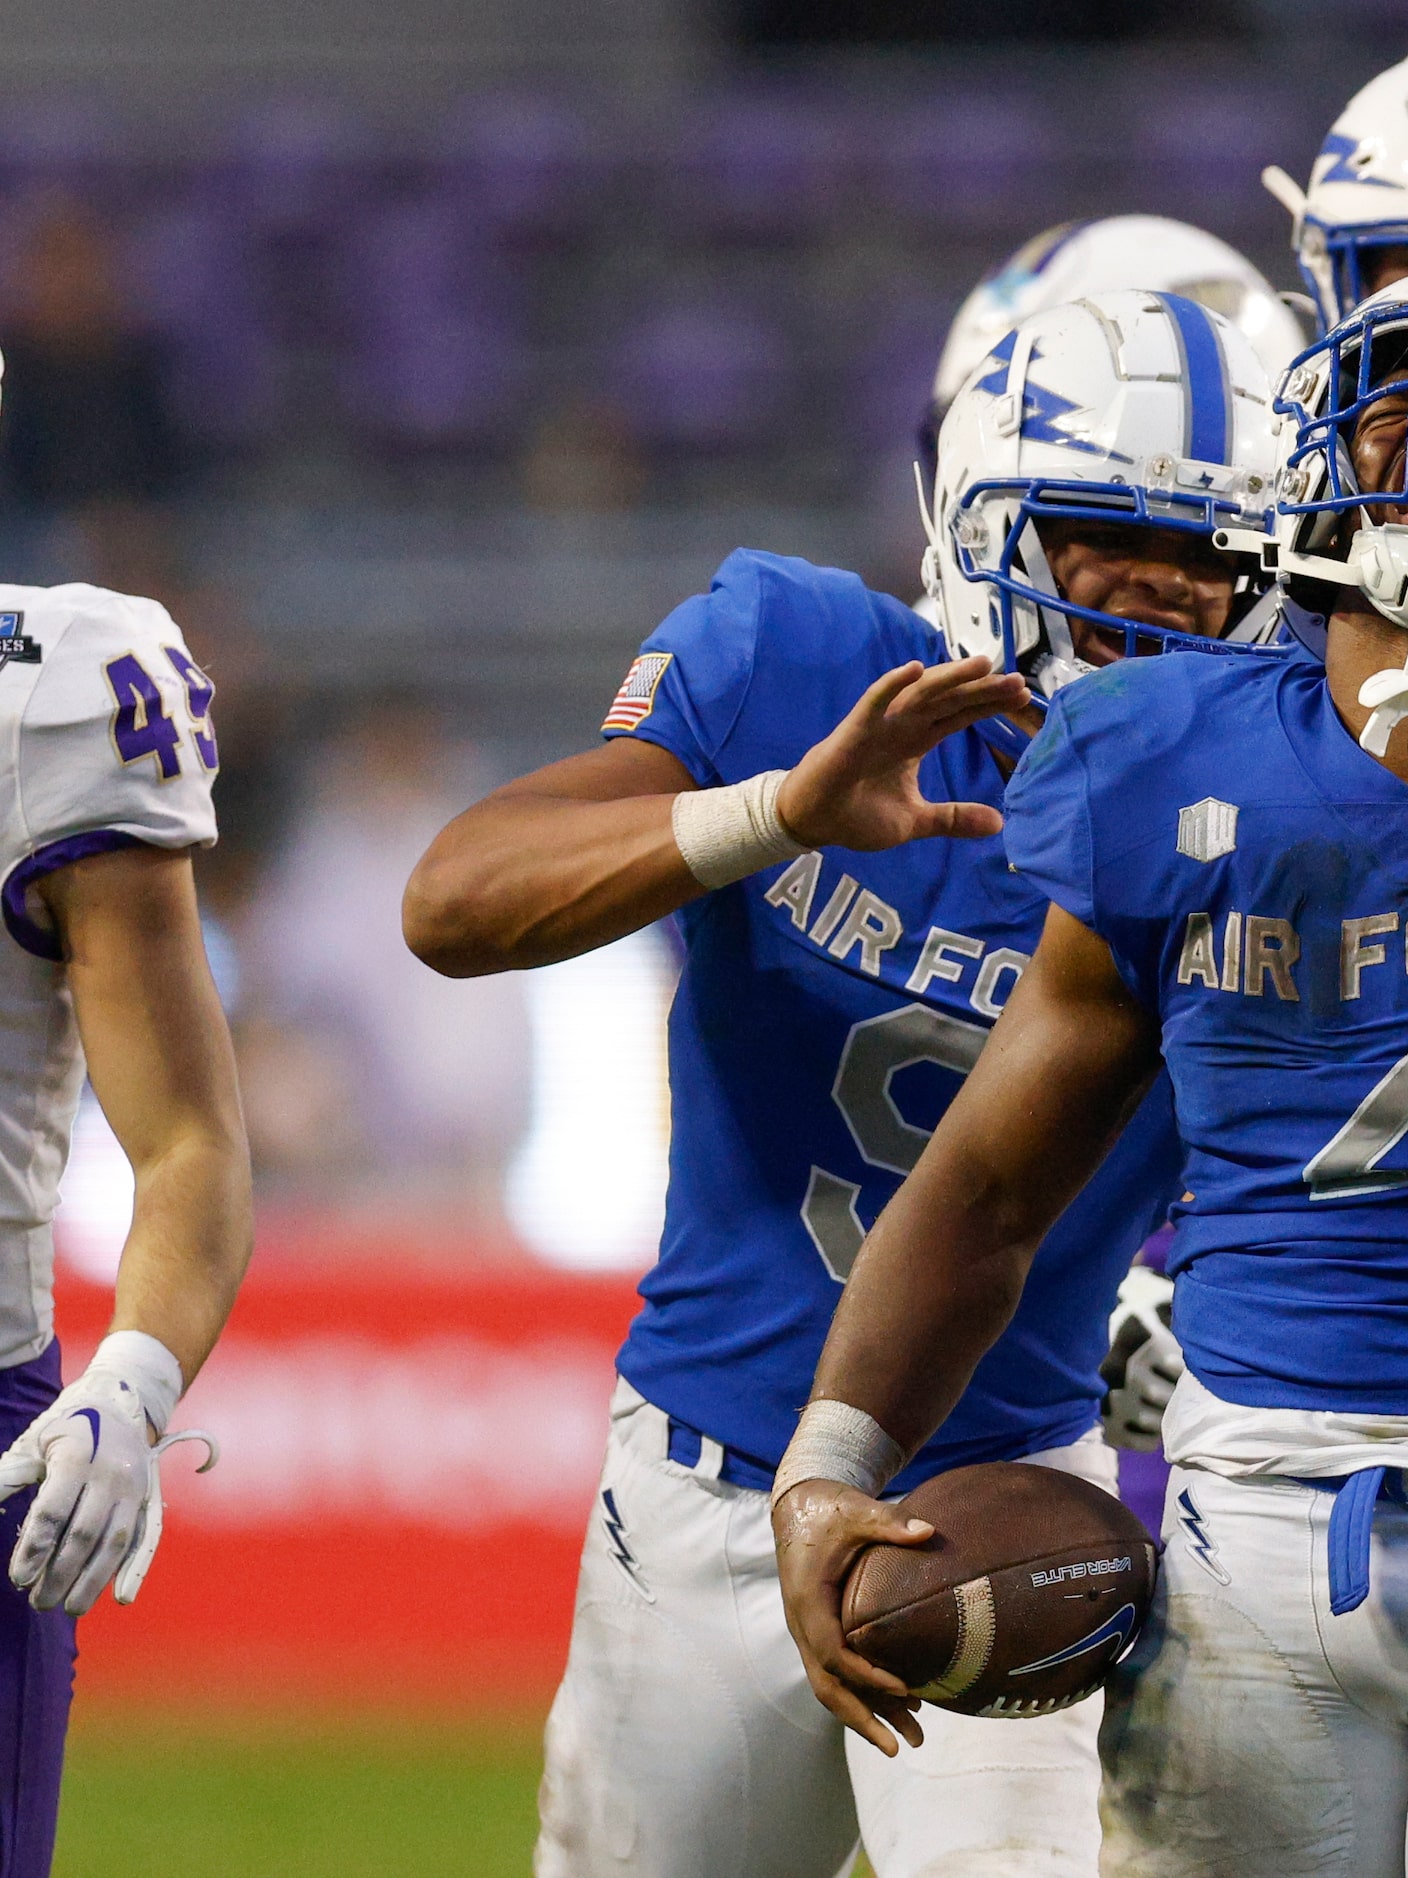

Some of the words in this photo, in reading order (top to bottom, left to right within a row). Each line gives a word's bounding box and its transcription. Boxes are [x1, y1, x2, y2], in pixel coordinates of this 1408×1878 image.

[101, 643, 219, 785] 49
[764, 849, 903, 977] AIR
[905, 926, 1033, 1019] FO
[1177, 911, 1301, 1002] AIR
[1030, 1562, 1086, 1588] ELITE
[1086, 1556, 1132, 1576] VAPOR
